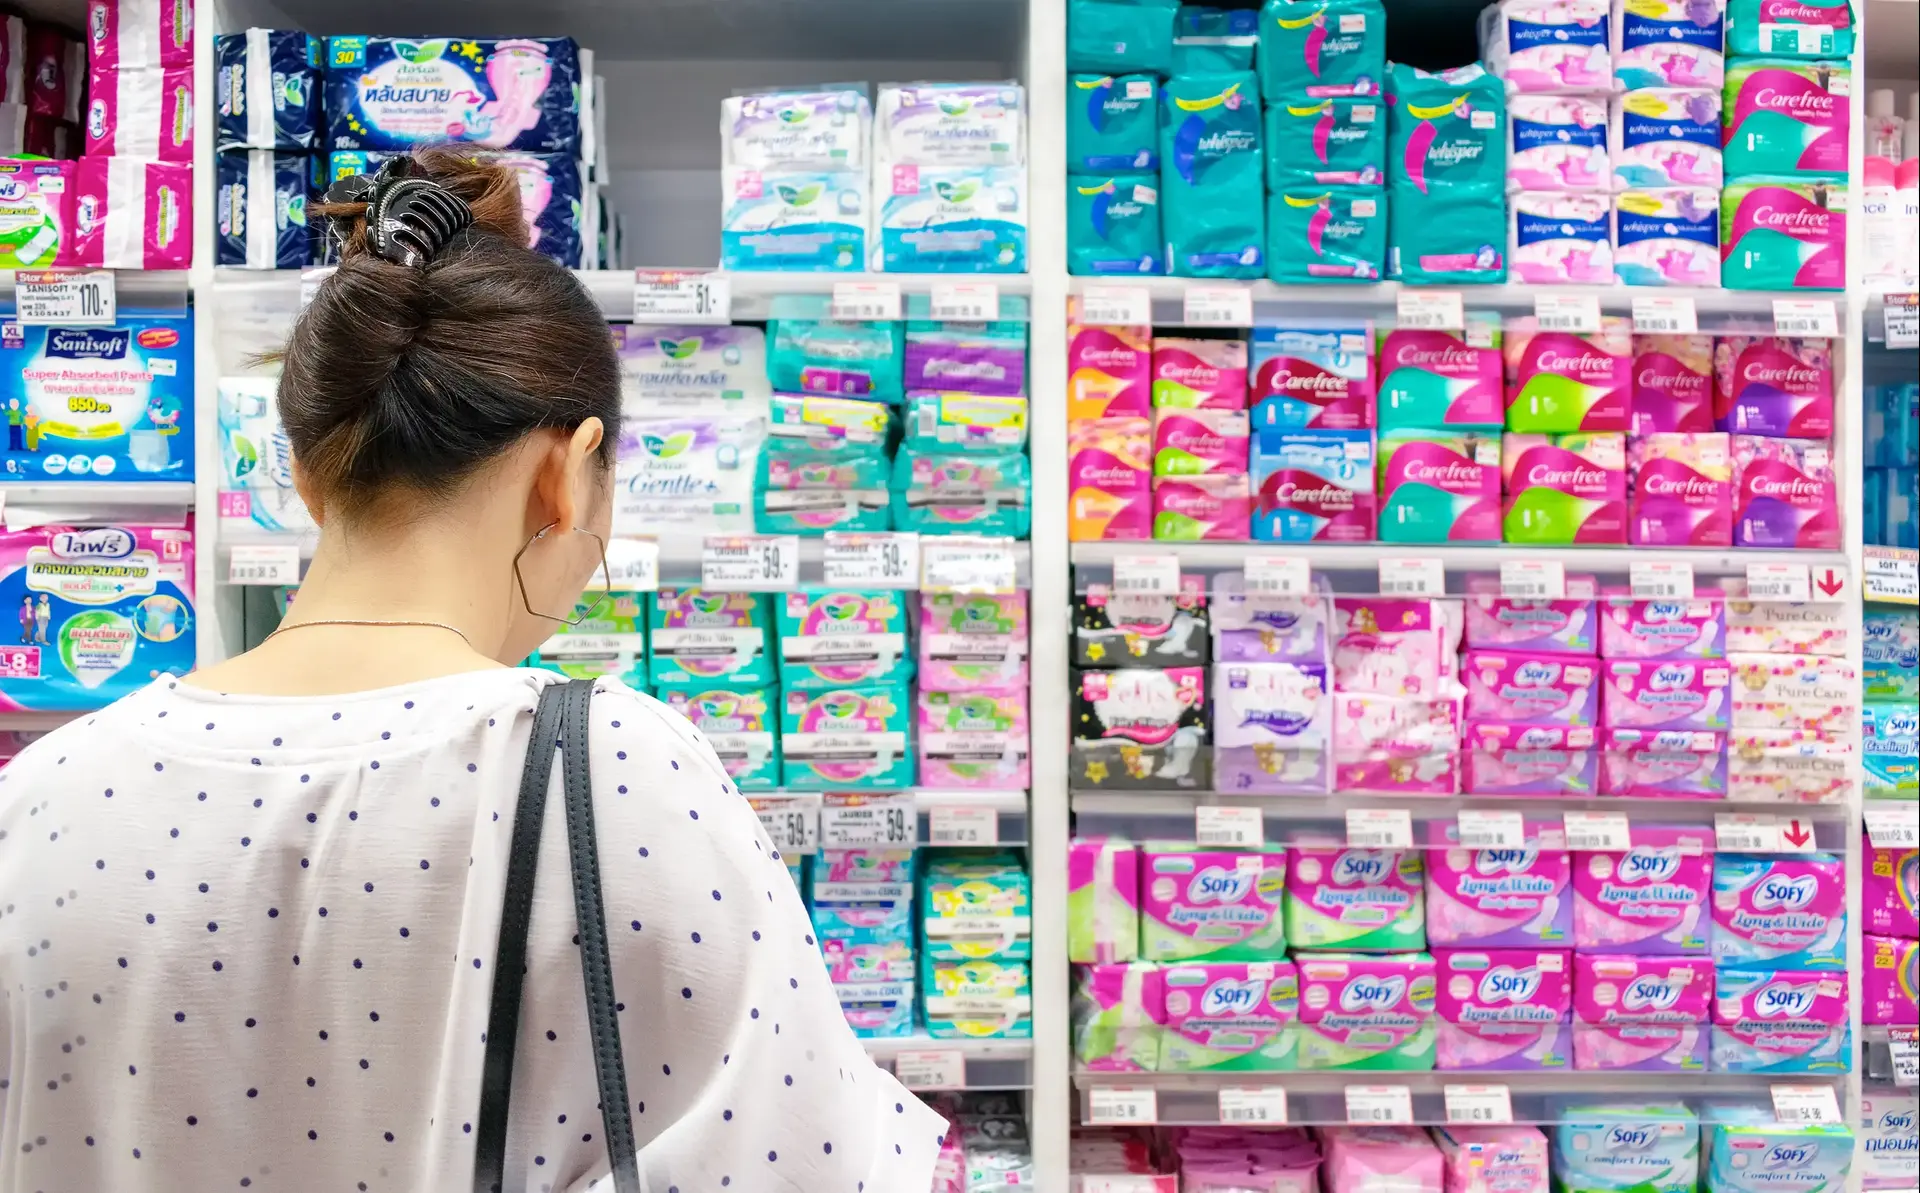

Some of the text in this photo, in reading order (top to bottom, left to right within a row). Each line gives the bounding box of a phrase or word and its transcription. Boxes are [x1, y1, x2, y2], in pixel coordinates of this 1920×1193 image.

[1768, 3, 1822, 18] Carefree
[1515, 29, 1552, 41] whisper
[1628, 25, 1665, 38] whisper
[1321, 37, 1361, 53] whisper
[335, 51, 354, 64] 30
[365, 84, 451, 102] หลับสบาย
[1755, 88, 1833, 109] Carefree
[1329, 128, 1368, 143] whisper
[1520, 128, 1555, 140] whisper
[1629, 125, 1666, 137] whisper
[1198, 133, 1252, 153] whisper
[1428, 141, 1483, 163] whisper
[1753, 206, 1829, 226] Carefree
[1324, 222, 1364, 237] whisper
[1523, 222, 1559, 235] whisper
[1623, 222, 1660, 235] whisper
[19, 273, 41, 283] Star
[26, 284, 69, 292] SANISOFT
[5, 326, 20, 337] XL
[52, 335, 123, 356] Sanisoft
[1080, 346, 1135, 361] Carefree
[1397, 344, 1479, 364] Carefree
[1537, 350, 1614, 371] Carefree
[23, 369, 153, 384] Super Absorbed Pants
[1160, 362, 1219, 378] Carefree
[1638, 368, 1704, 388] Carefree
[1744, 362, 1820, 381] Carefree
[1271, 369, 1349, 390] Carefree
[69, 396, 97, 412] 850
[1168, 431, 1225, 446] Carefree
[1080, 465, 1136, 480] Carefree
[1404, 459, 1482, 480] Carefree
[1528, 464, 1607, 484] Carefree
[629, 472, 702, 494] Gentle
[1644, 474, 1719, 494] Carefree
[1750, 475, 1824, 494] Carefree
[1276, 483, 1353, 503] Carefree
[1653, 603, 1680, 616] SOFY
[1763, 609, 1837, 623] Pure Care
[1866, 623, 1892, 637] SOFY
[1524, 667, 1551, 680] SOFY
[1659, 671, 1686, 683] SOFY
[1775, 683, 1847, 699] Pure Care
[1890, 717, 1917, 732] SOFY
[1774, 757, 1845, 772] Pure Care
[1488, 848, 1527, 866] SOFY
[1630, 856, 1670, 873] SOFY
[1345, 858, 1382, 876] SOFY
[1200, 878, 1239, 895] SOFY
[1764, 883, 1805, 902] SOFY
[1735, 913, 1772, 929] Long
[1786, 915, 1825, 928] Wide
[1491, 976, 1530, 993] SOFY
[1635, 984, 1673, 1000] SOFY
[1214, 988, 1251, 1005] SOFY
[1353, 986, 1391, 1003] SOFY
[1766, 989, 1805, 1008] SOFY
[1885, 1114, 1912, 1128] SOFY
[1613, 1128, 1648, 1144] SOFY
[1498, 1153, 1520, 1163] SOFY
[1585, 1155, 1671, 1166] Comfort Fresh
[1771, 1147, 1807, 1163] SOFY
[1741, 1171, 1826, 1182] Comfort Fresh
